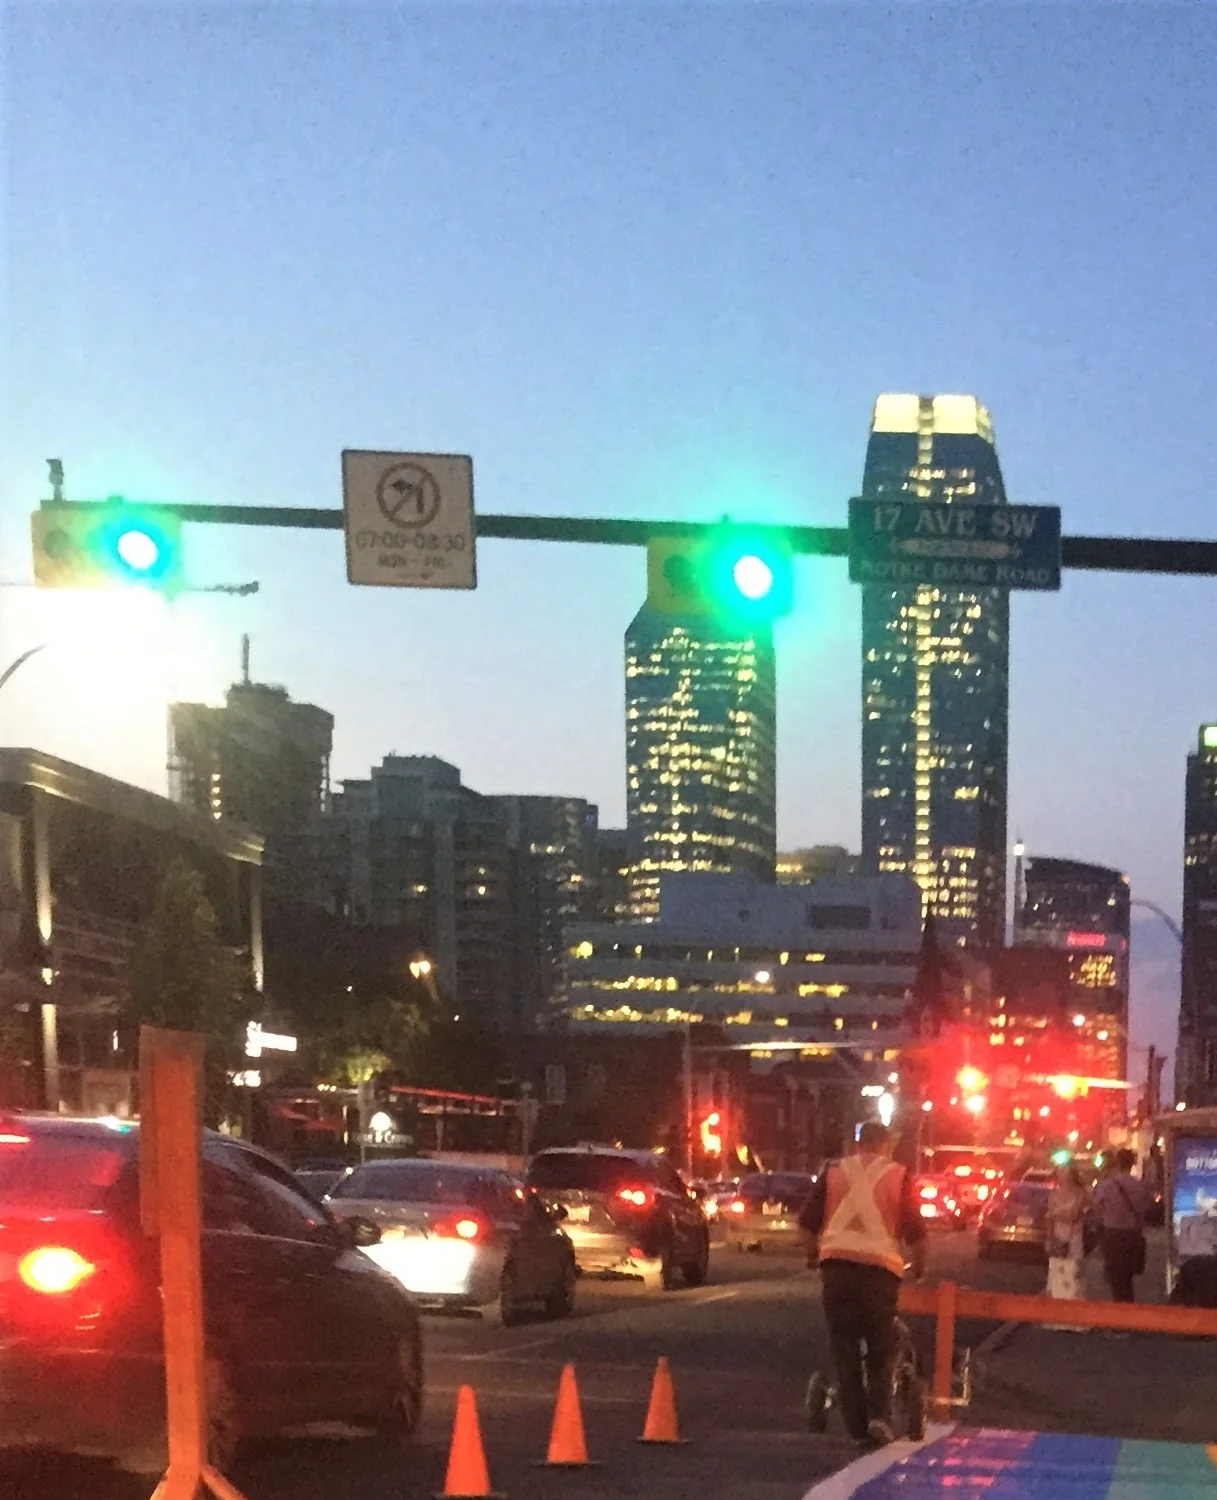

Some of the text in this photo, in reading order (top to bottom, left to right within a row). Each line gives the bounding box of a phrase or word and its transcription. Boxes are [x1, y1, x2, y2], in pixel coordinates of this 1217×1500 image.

[873, 505, 1040, 537] 17 AVE SW
